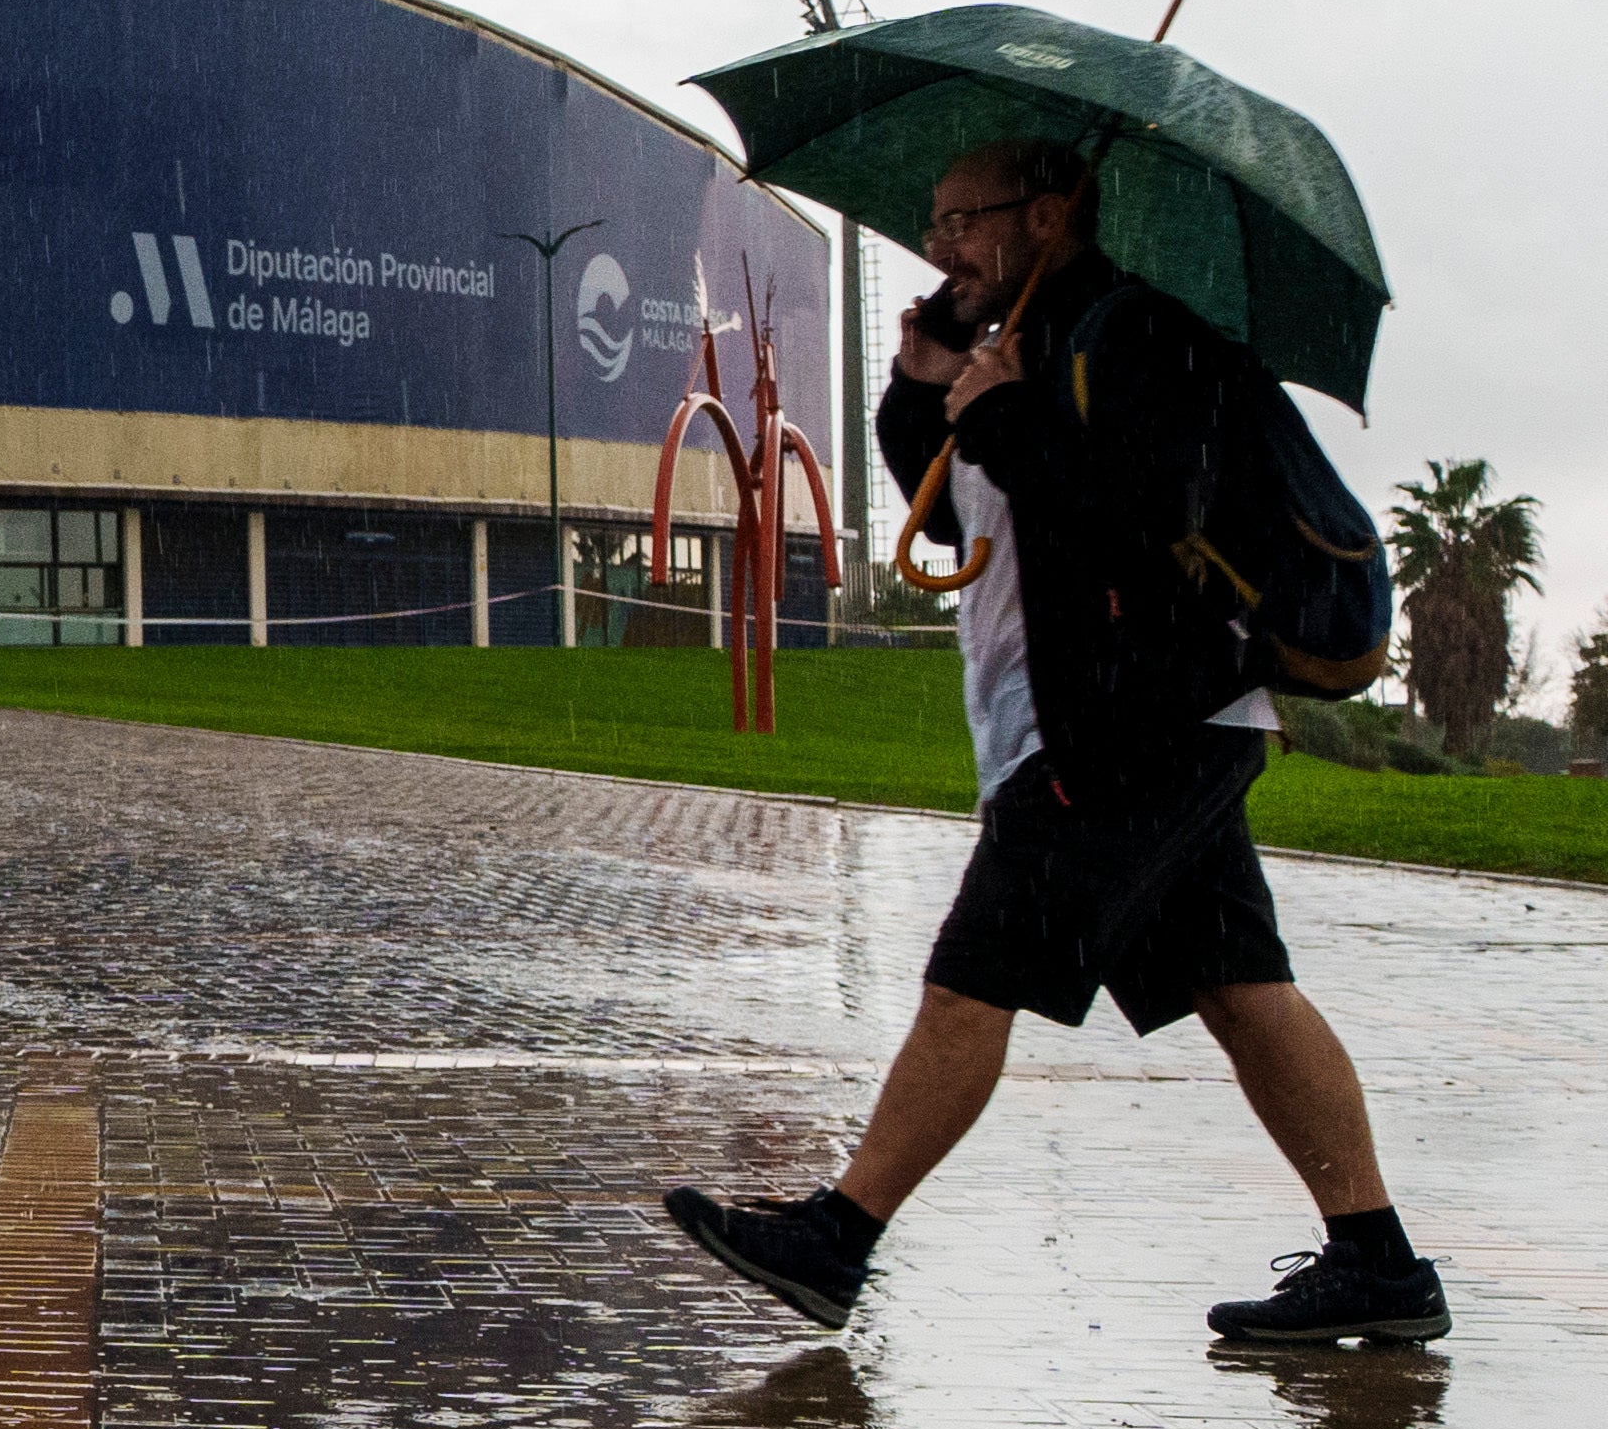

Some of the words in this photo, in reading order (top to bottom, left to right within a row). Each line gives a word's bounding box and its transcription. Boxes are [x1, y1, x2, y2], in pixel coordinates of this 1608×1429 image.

[227, 238, 374, 287] Diputación
[381, 252, 495, 299] Provincial
[227, 295, 264, 332] de
[272, 294, 370, 347] Málaga
[641, 297, 681, 324] COSTA
